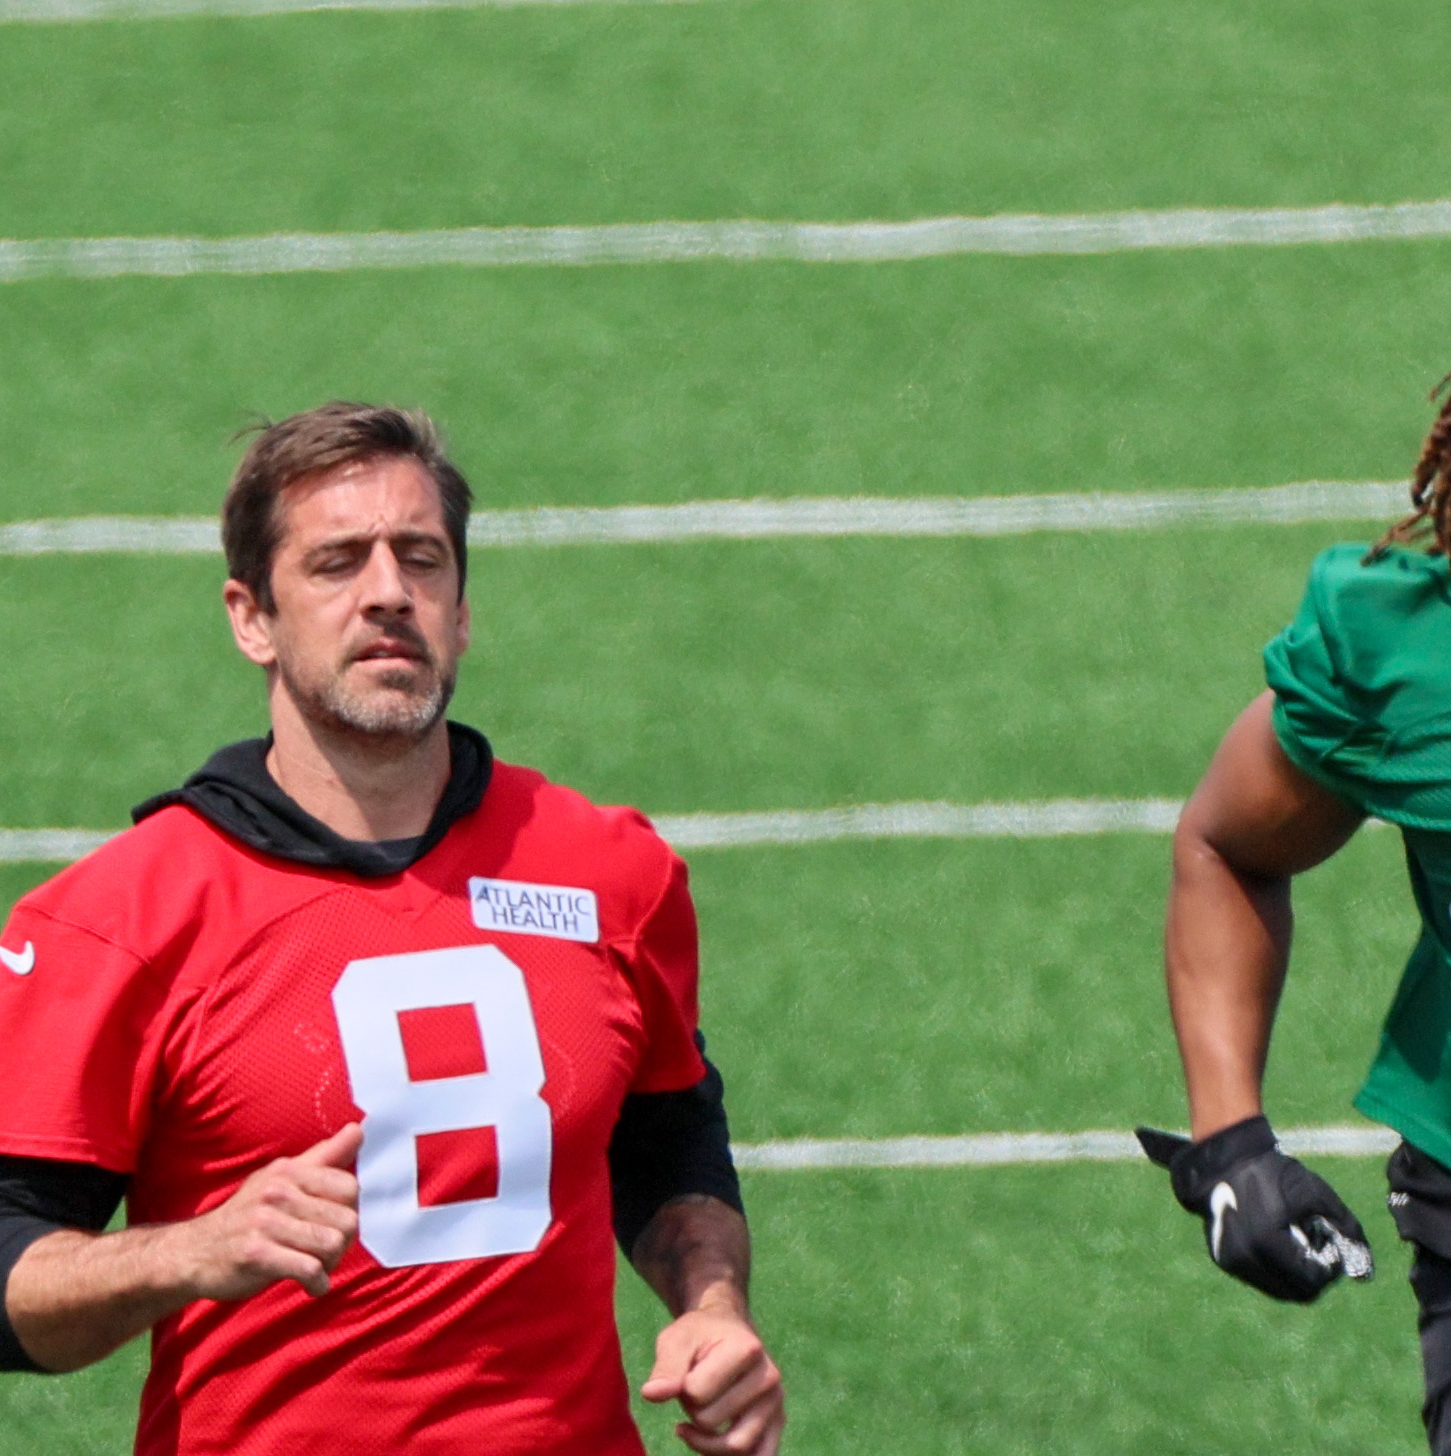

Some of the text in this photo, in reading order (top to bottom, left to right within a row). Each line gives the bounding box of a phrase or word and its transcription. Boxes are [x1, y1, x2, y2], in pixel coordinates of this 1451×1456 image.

[475, 885, 591, 916] ATLANTIC
[492, 905, 579, 933] HEALTH
[331, 943, 552, 1268] 8
